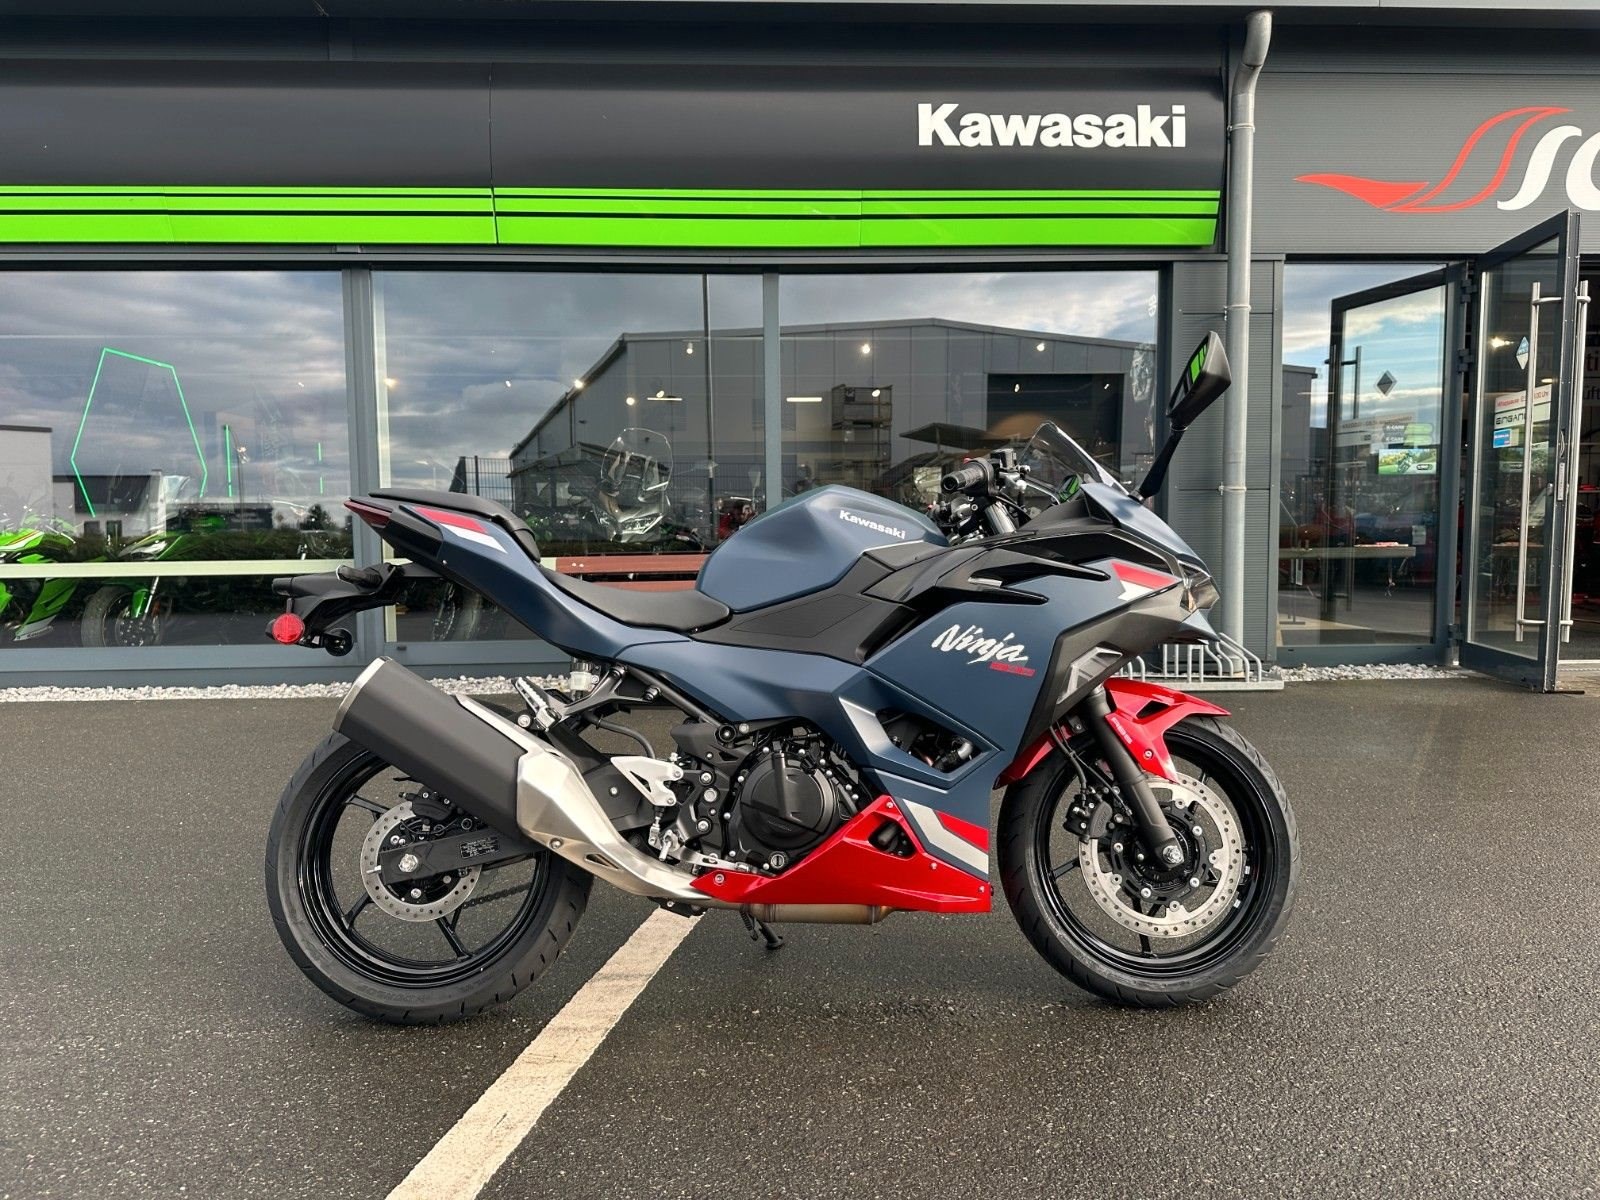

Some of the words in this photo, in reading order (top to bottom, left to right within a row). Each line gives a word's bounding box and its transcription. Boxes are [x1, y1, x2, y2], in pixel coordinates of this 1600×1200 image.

[918, 103, 1186, 148] Kawasaki
[1496, 413, 1527, 425] EINGAN
[840, 510, 906, 540] Kawasaki
[931, 624, 1029, 665] Ninja
